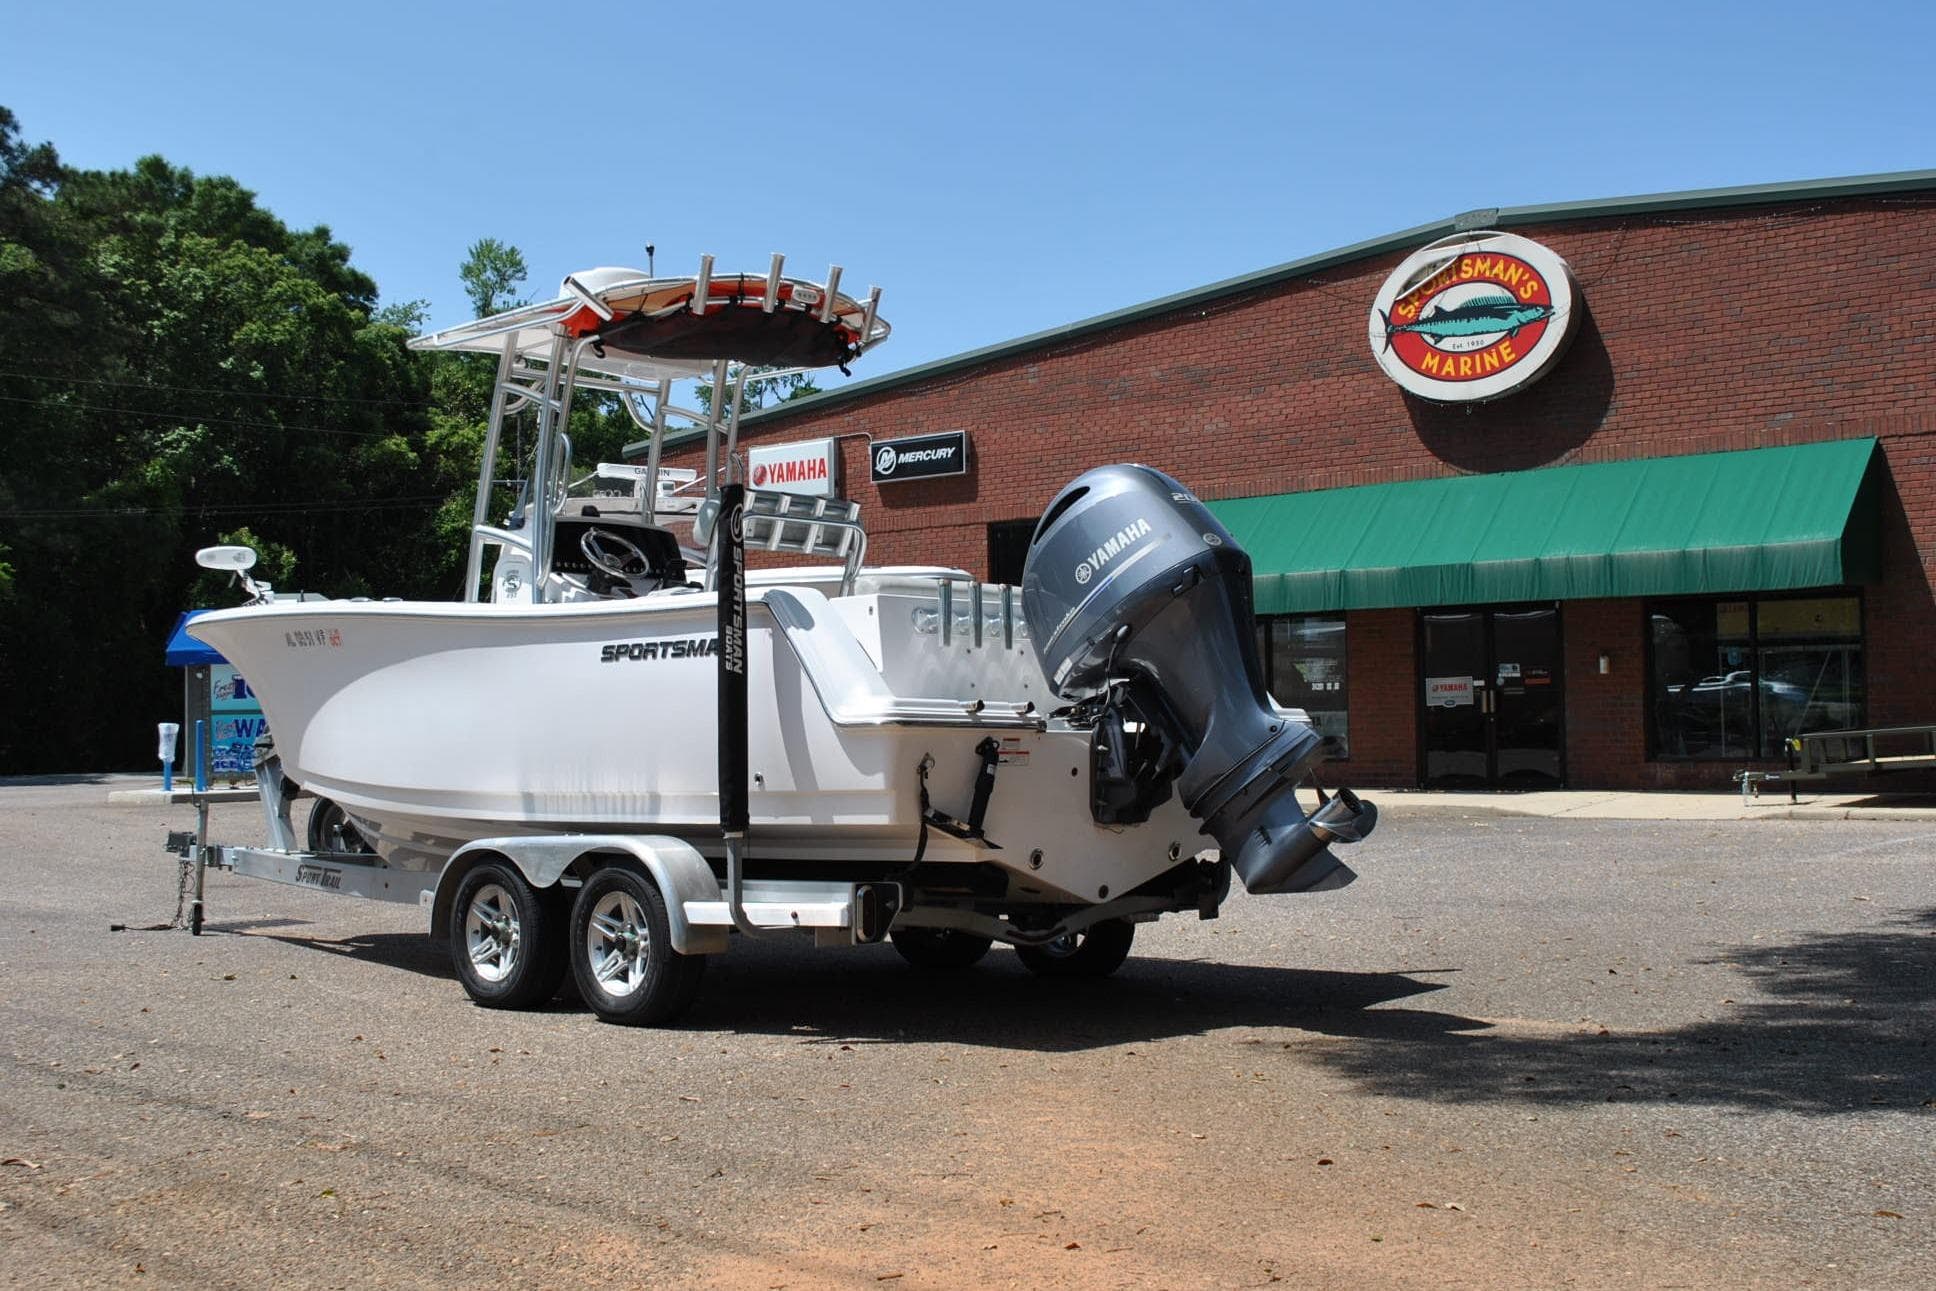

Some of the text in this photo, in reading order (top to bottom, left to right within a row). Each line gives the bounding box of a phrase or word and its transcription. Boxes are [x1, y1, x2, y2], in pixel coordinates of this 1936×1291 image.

[1421, 340, 1517, 376] MARINE
[769, 457, 827, 484] YAMAHA
[898, 446, 956, 464] MERCURY
[1087, 518, 1152, 570] YAMAHA
[733, 546, 743, 674] SPORTSMAN
[601, 638, 719, 663] SPORTSMA
[725, 625, 733, 672] BOATS
[1441, 683, 1468, 692] YAMAHA
